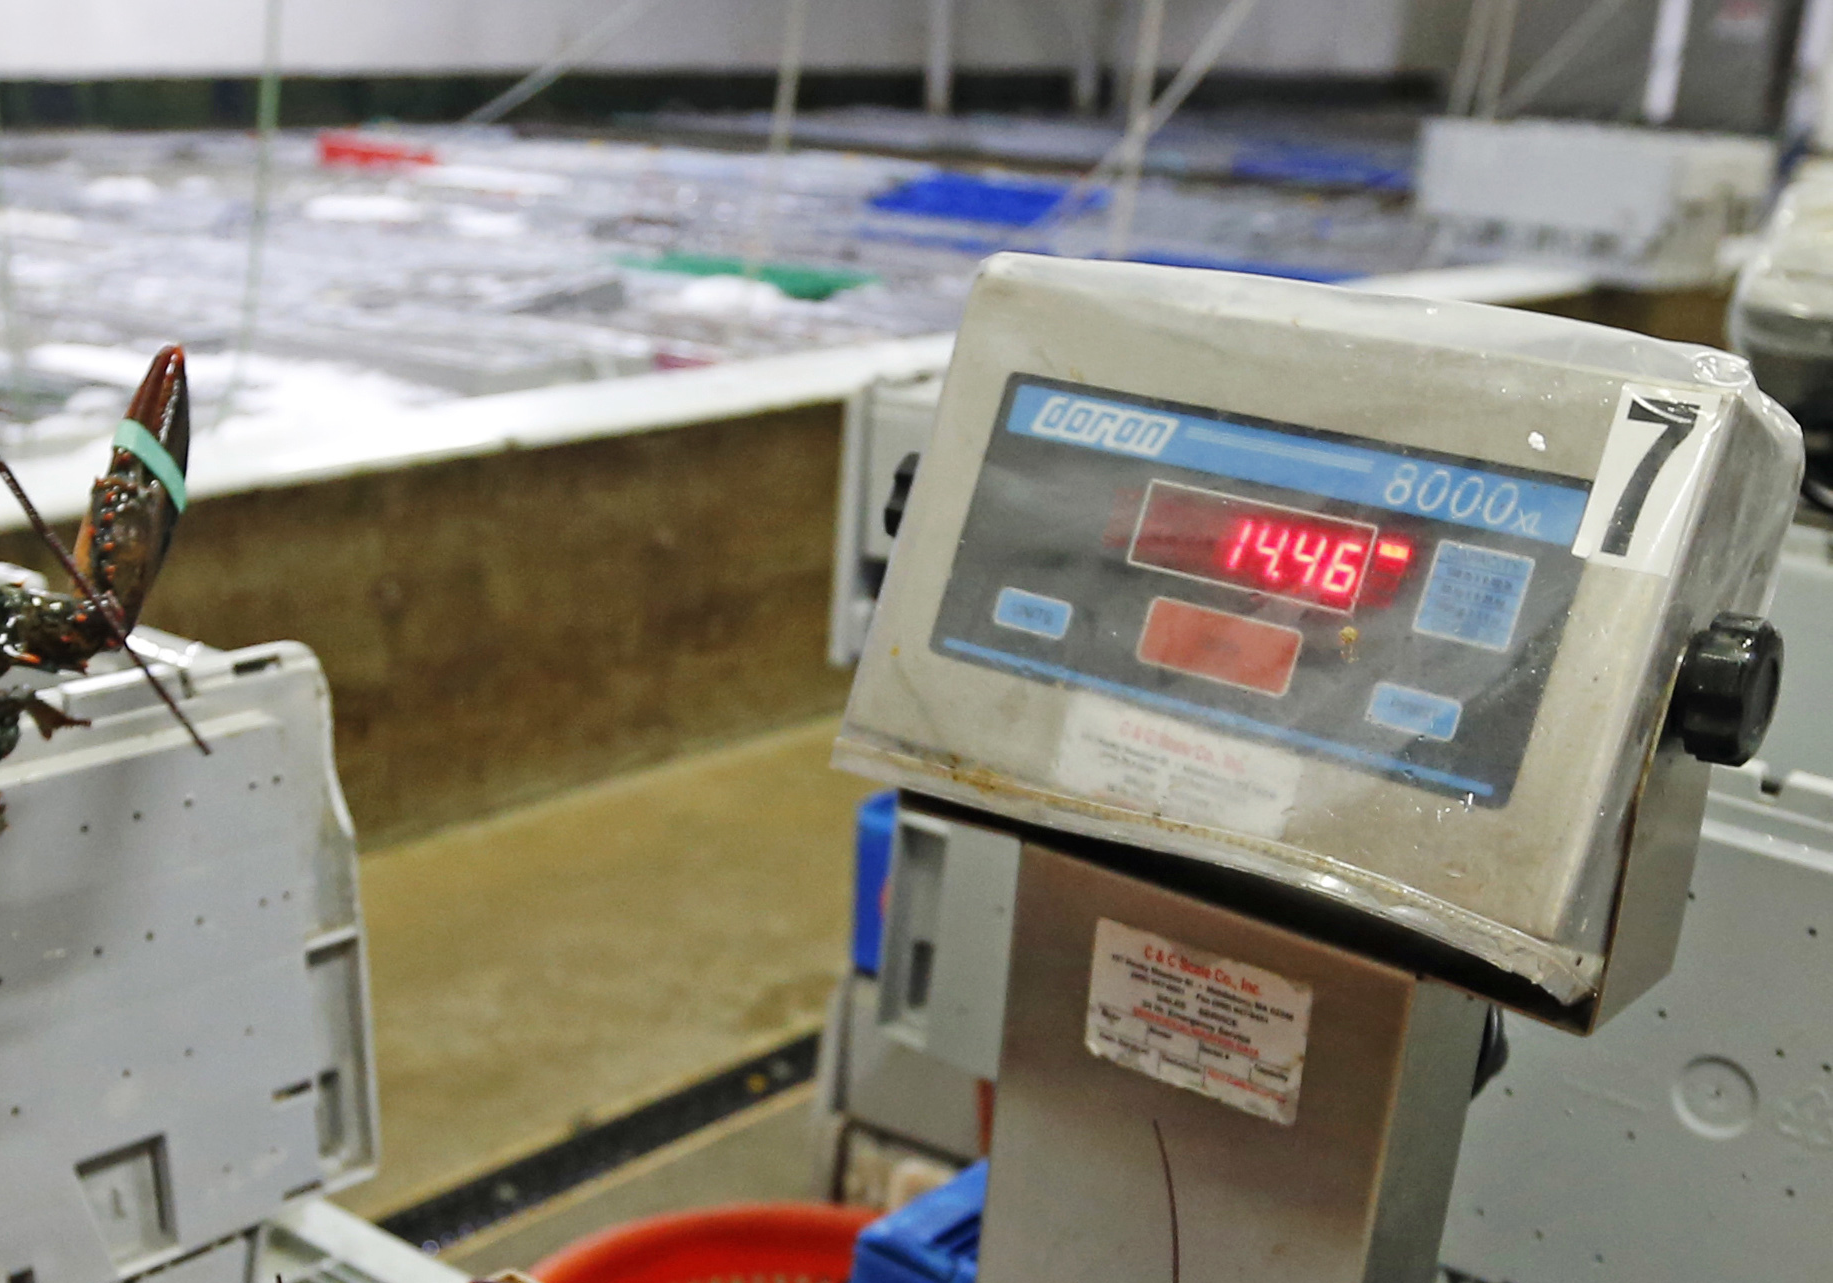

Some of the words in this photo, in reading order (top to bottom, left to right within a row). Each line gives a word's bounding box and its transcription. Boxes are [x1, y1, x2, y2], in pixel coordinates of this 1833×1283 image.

[1031, 396, 1180, 457] doran
[1600, 397, 1701, 557] 7
[1226, 519, 1363, 594] 14.46
[1144, 945, 1153, 961] C
[1167, 953, 1176, 968] C
